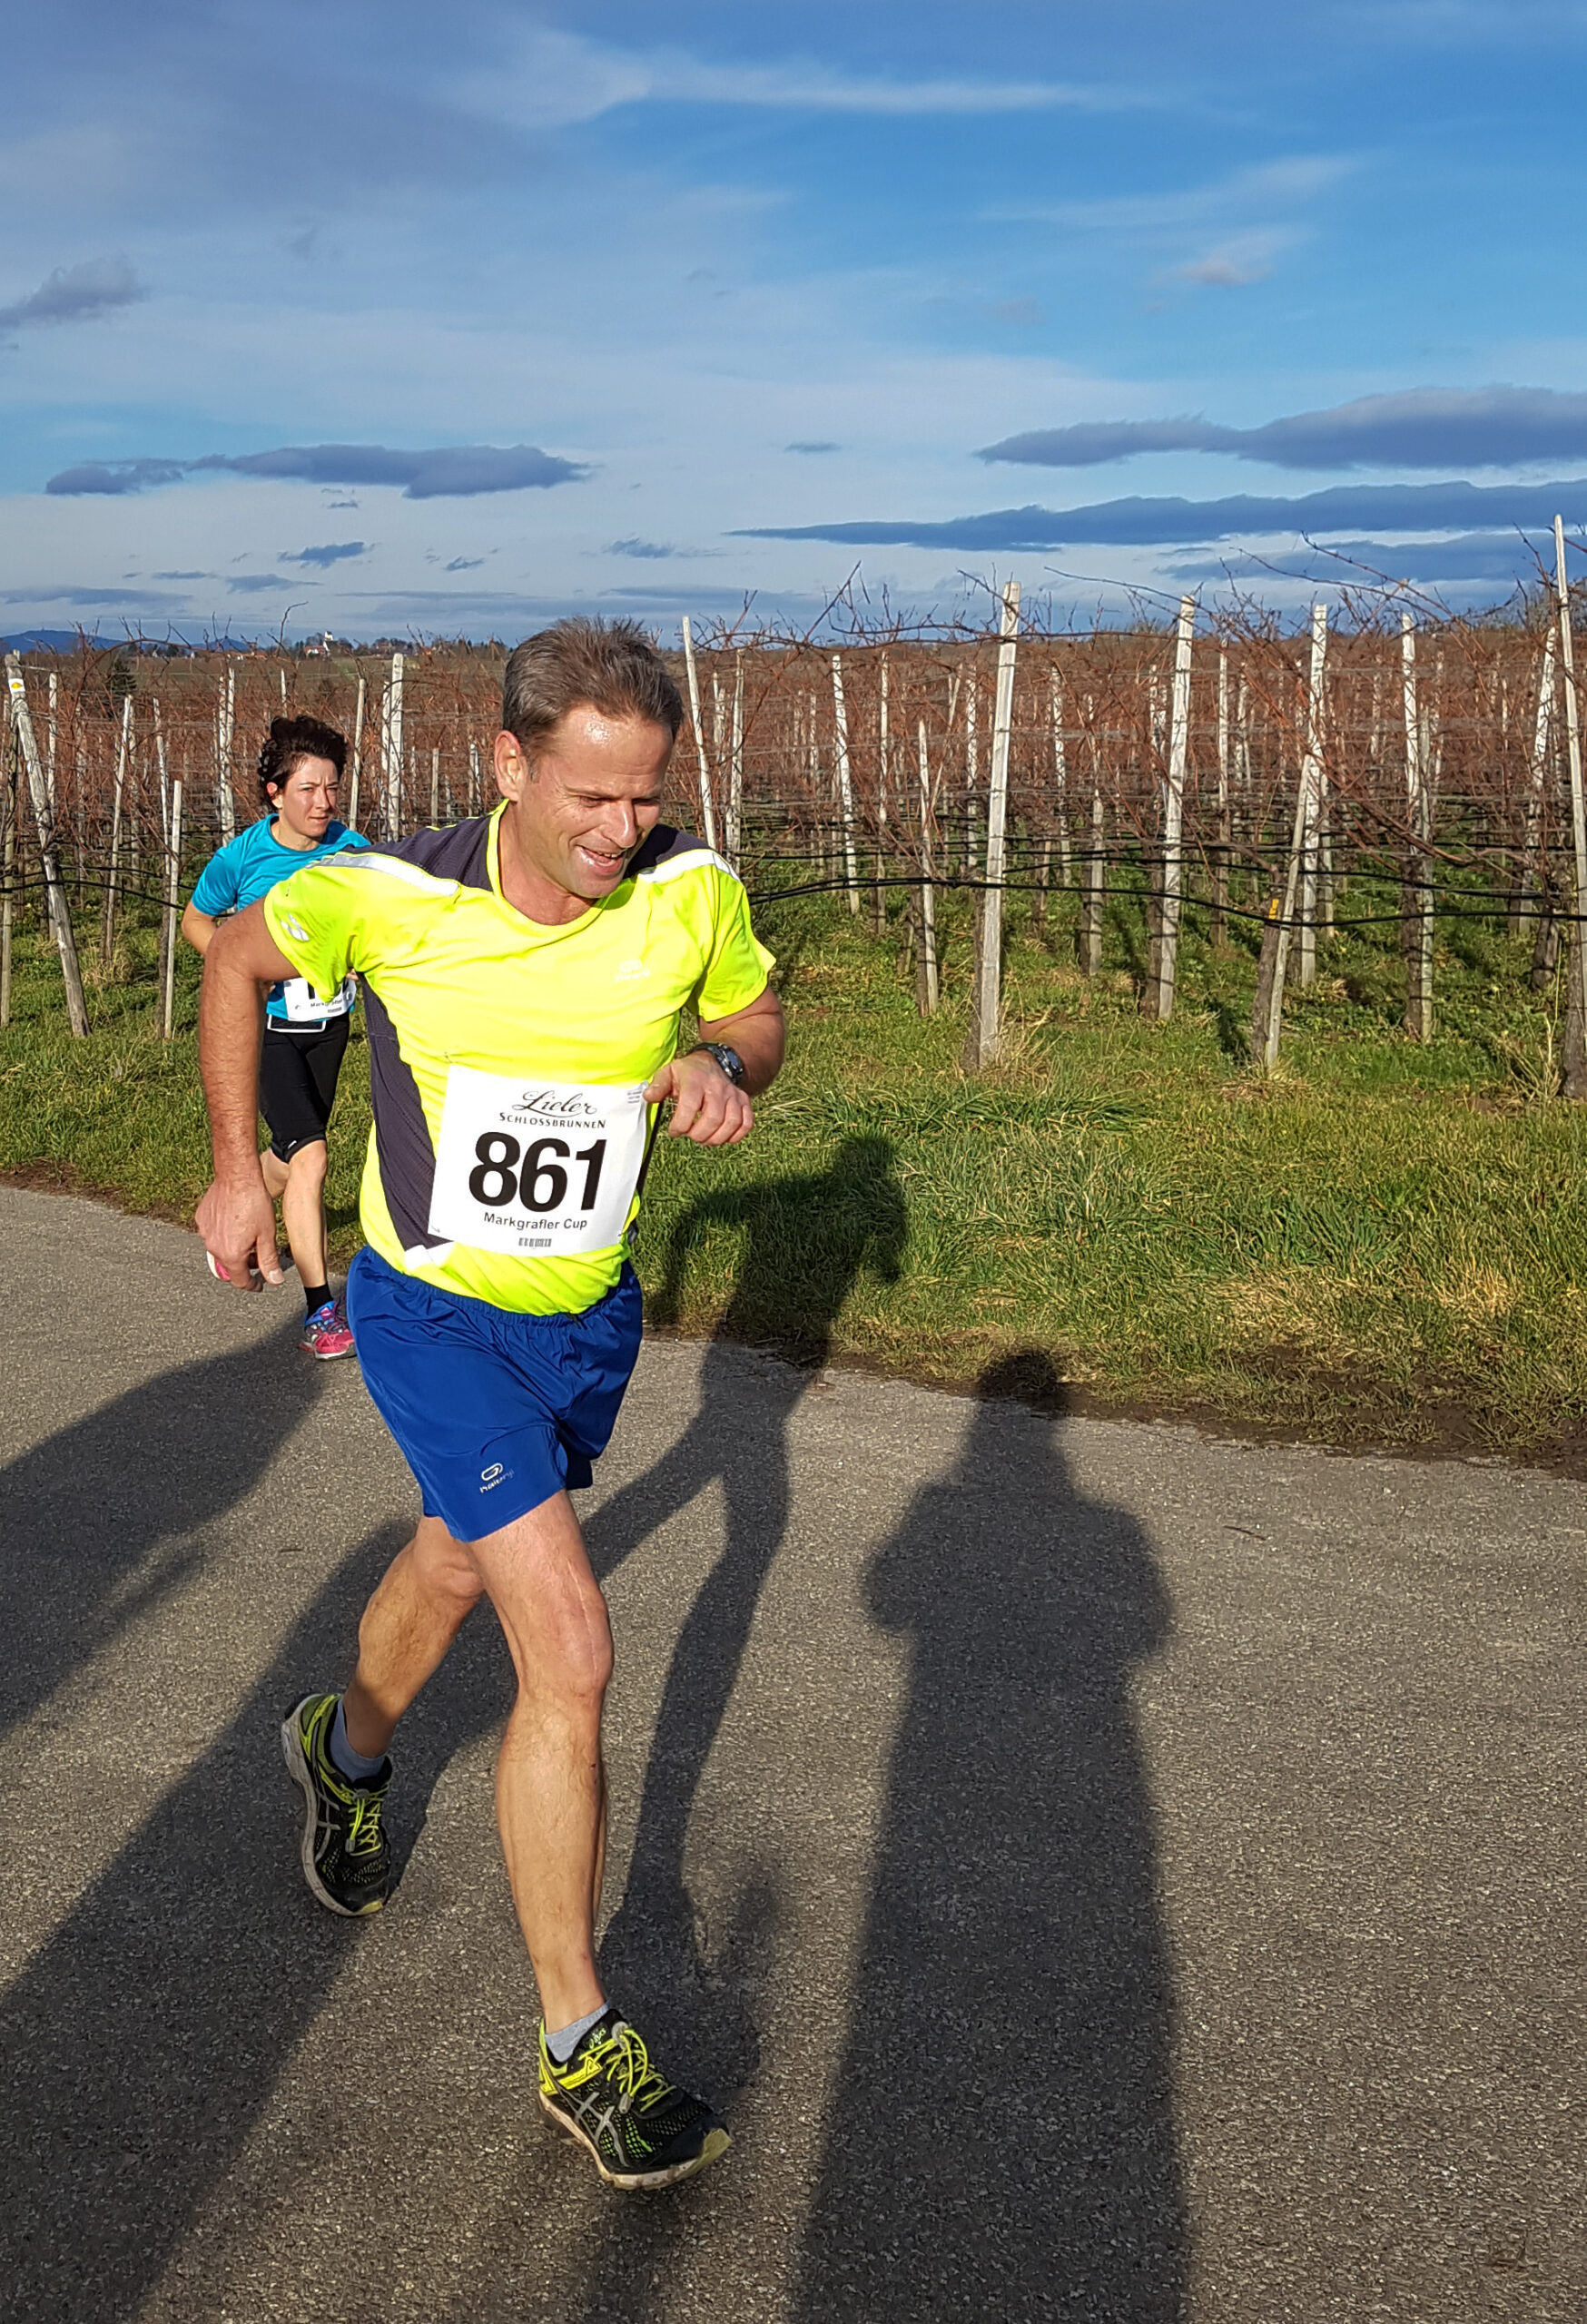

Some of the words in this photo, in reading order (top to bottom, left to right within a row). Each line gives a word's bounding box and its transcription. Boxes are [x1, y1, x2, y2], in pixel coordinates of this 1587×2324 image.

[499, 1112, 606, 1128] SCHLOSSBRUNNEN
[468, 1131, 607, 1213] 861
[564, 1218, 587, 1230] Cup
